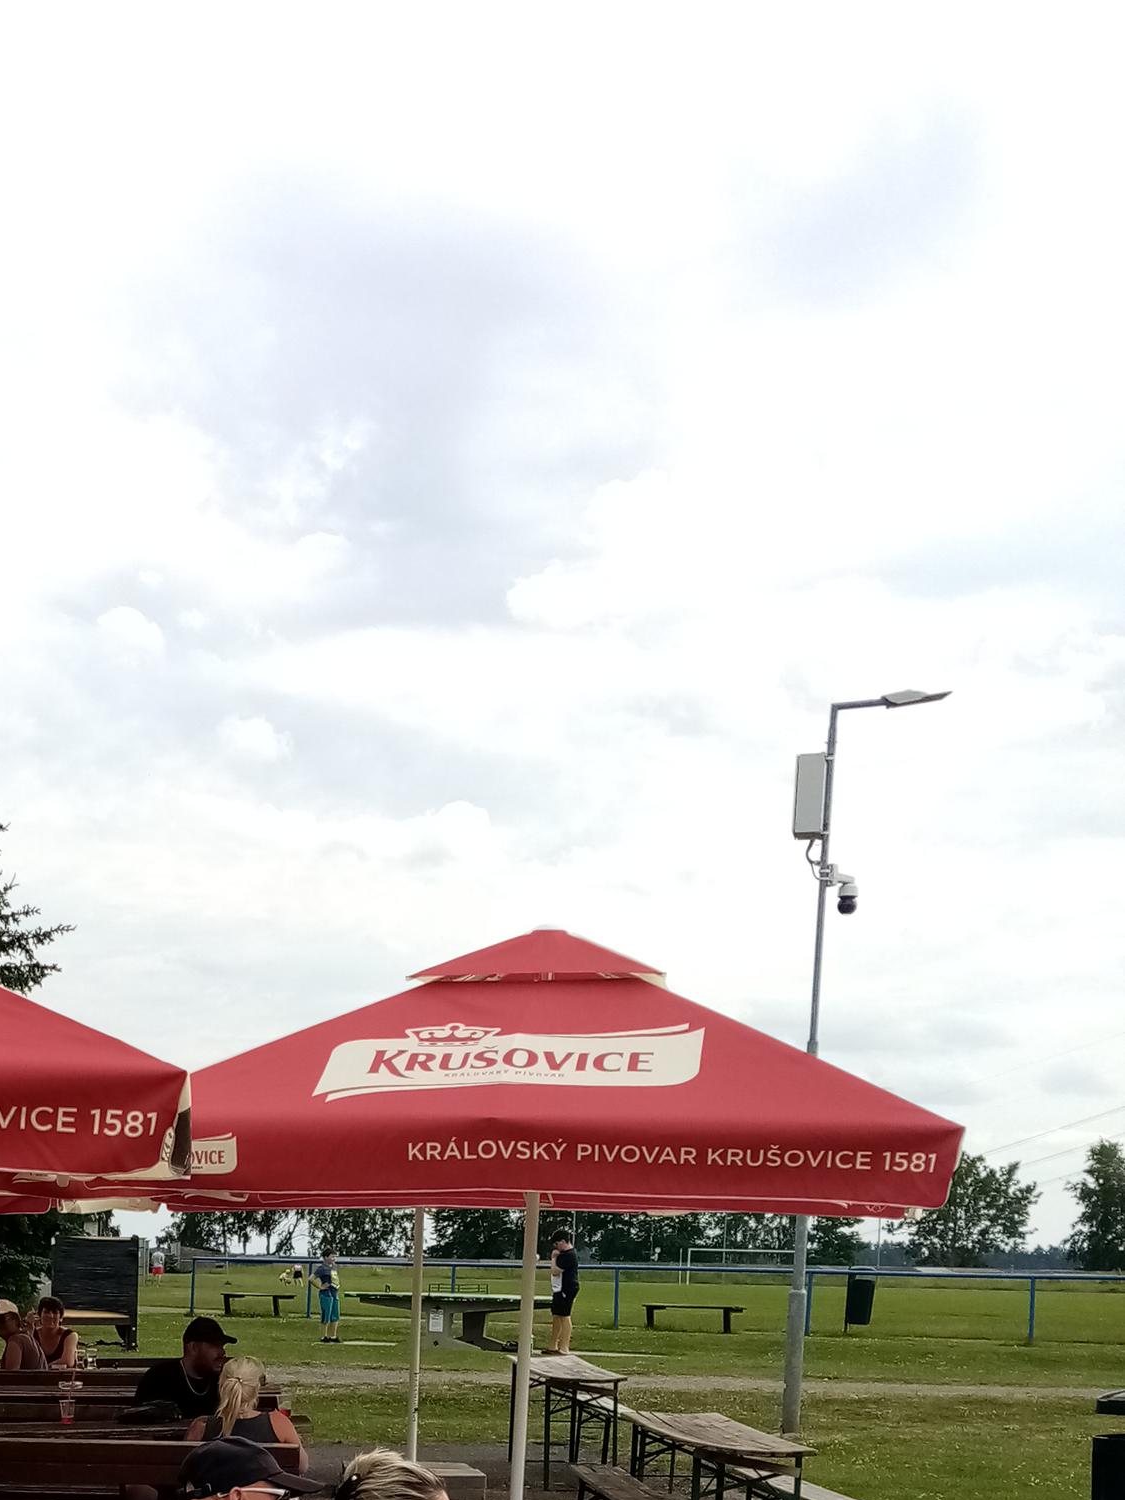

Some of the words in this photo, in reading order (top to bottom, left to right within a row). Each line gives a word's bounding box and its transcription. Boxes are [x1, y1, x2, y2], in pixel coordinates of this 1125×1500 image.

[366, 1045, 654, 1079] KRUŠOVICE
[90, 1107, 159, 1138] 1581
[407, 1137, 568, 1161] KRÁLOVSKÝ
[576, 1143, 697, 1166] PIVOVAR
[706, 1145, 873, 1170] KRUŠOVICE
[882, 1151, 938, 1173] 1581
